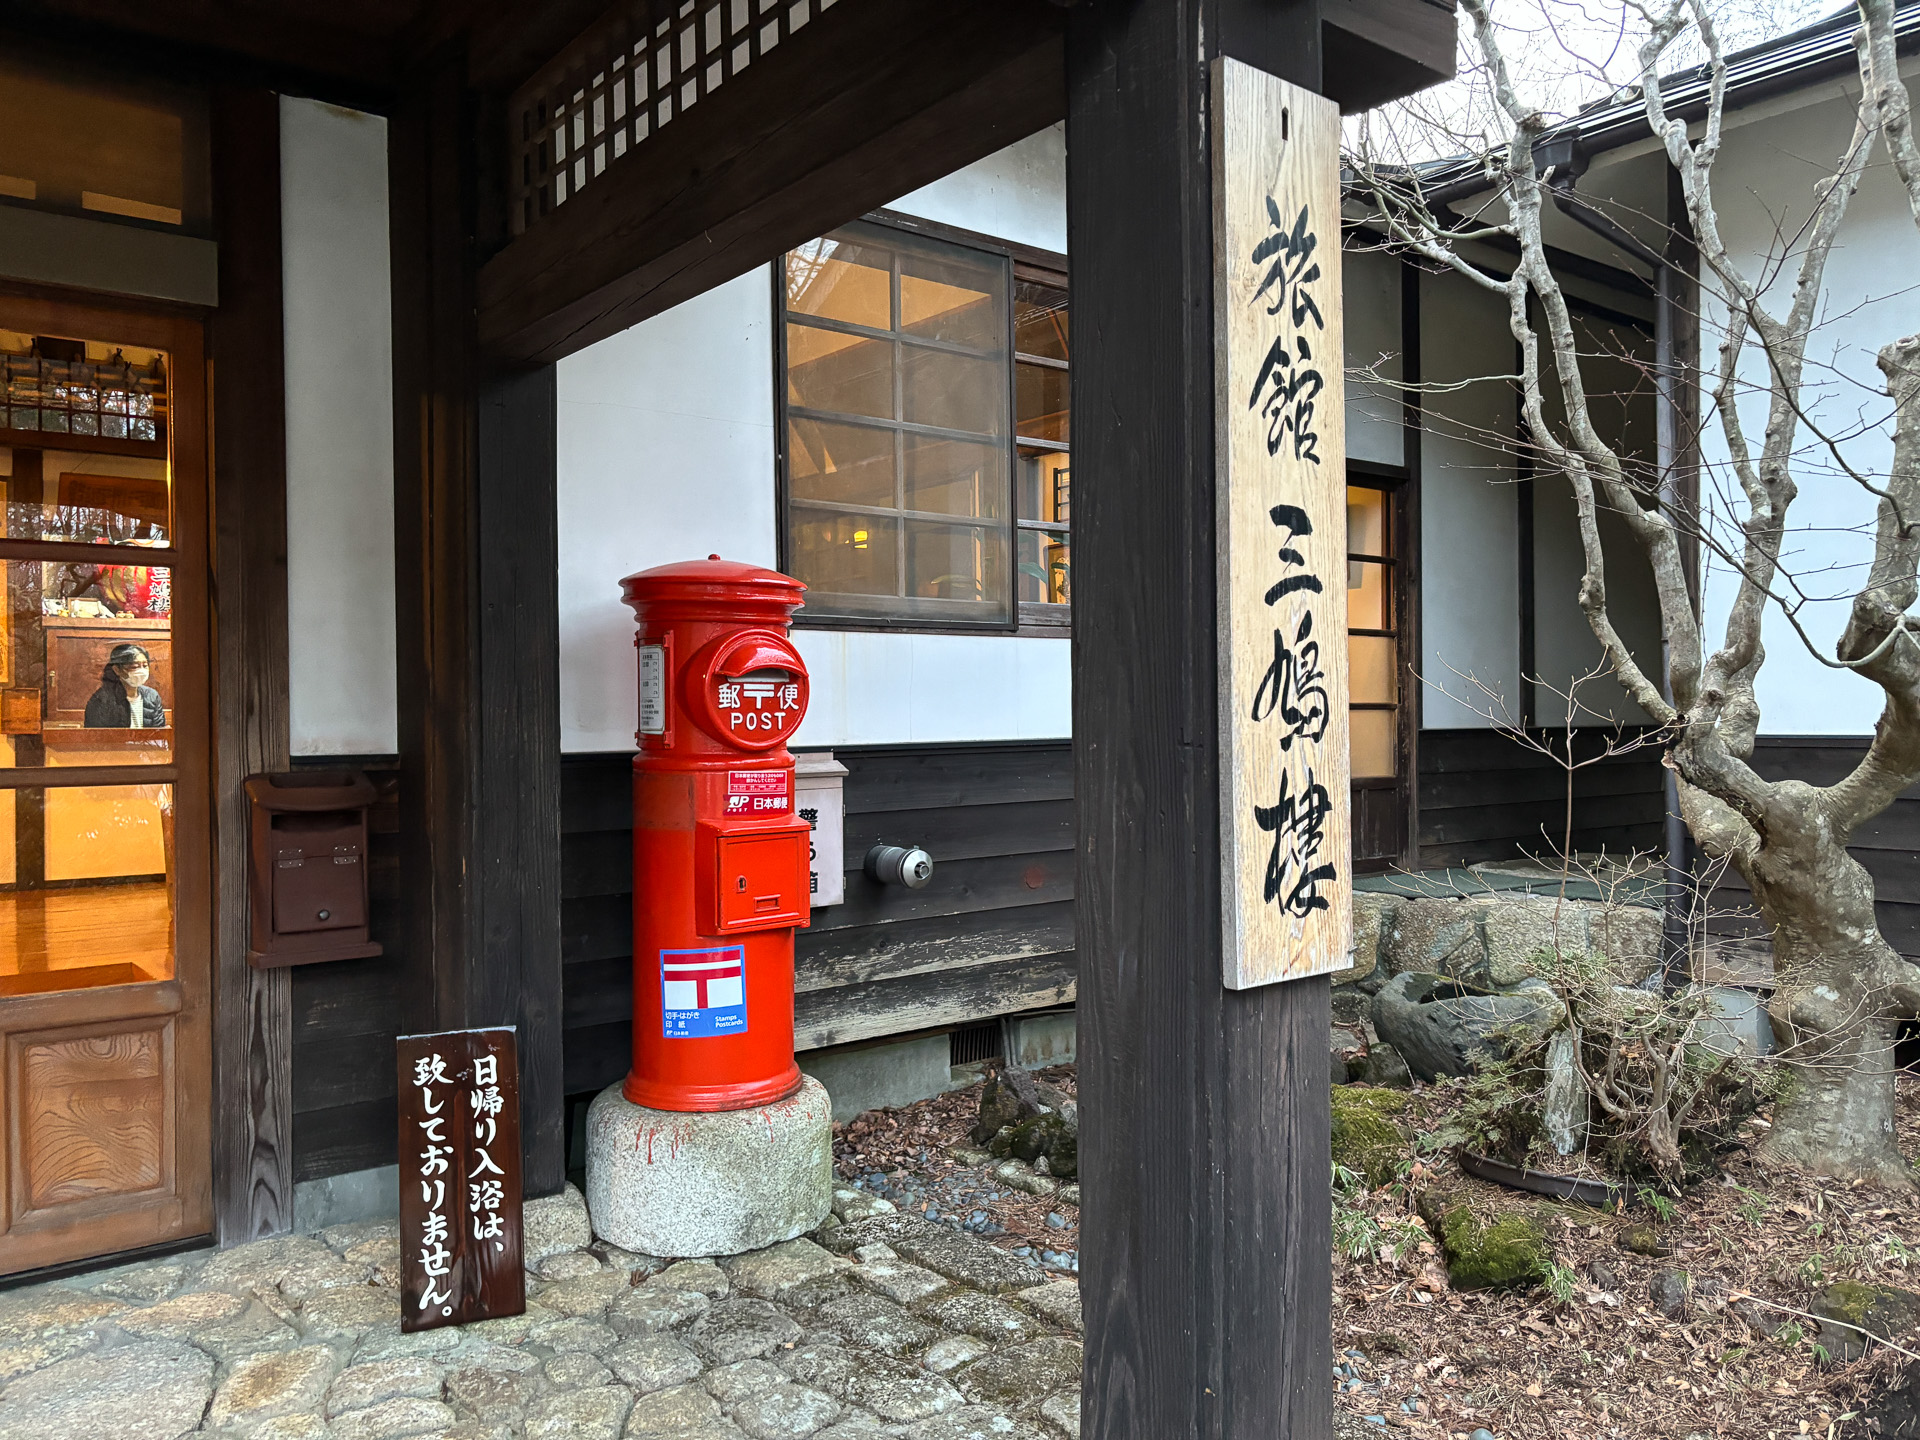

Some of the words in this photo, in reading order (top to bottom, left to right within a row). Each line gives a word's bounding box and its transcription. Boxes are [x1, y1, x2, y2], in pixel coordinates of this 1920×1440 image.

[1248, 194, 1324, 466] 旅館
[730, 712, 787, 731] POST
[754, 796, 788, 810] 日本郵便
[715, 1019, 743, 1028] Postcards
[412, 1053, 454, 1317] 致しておりません。
